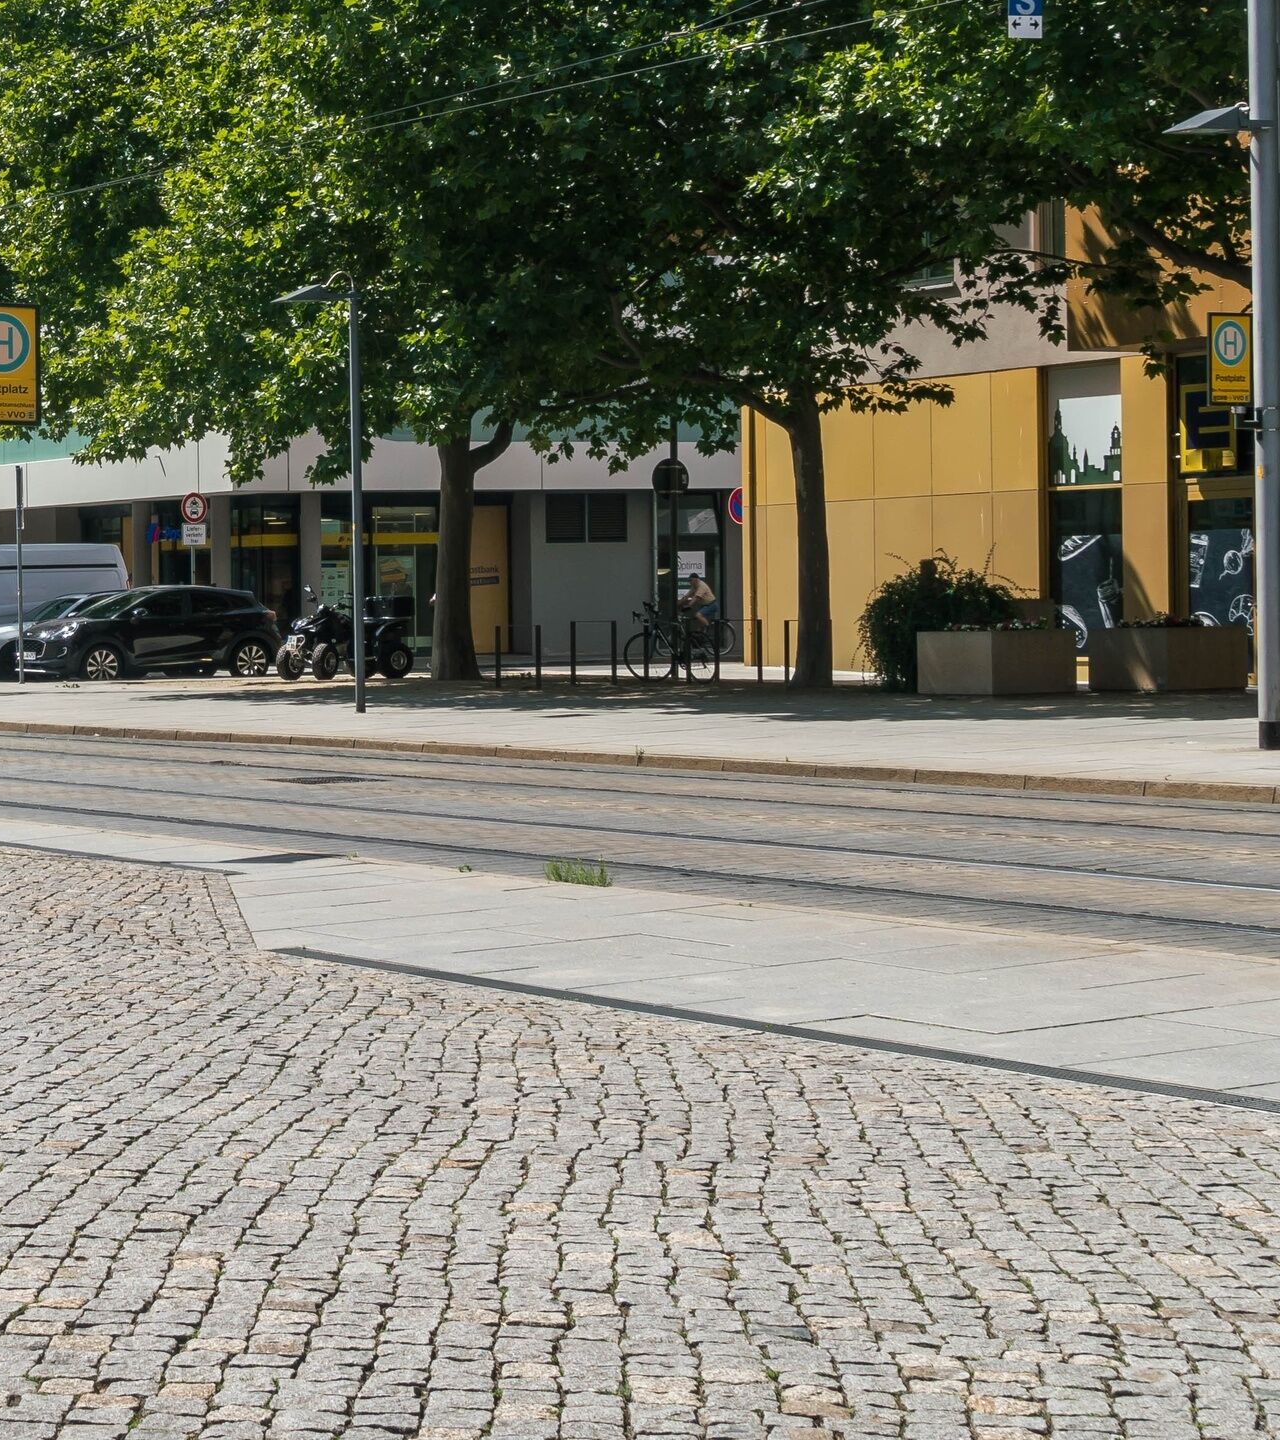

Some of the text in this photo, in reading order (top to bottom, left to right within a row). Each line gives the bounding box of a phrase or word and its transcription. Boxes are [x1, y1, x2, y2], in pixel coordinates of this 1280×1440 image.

[1224, 330, 1237, 356] H
[1216, 374, 1246, 383] Postplatz
[7, 411, 26, 419] VVO
[469, 564, 500, 574] ostbank
